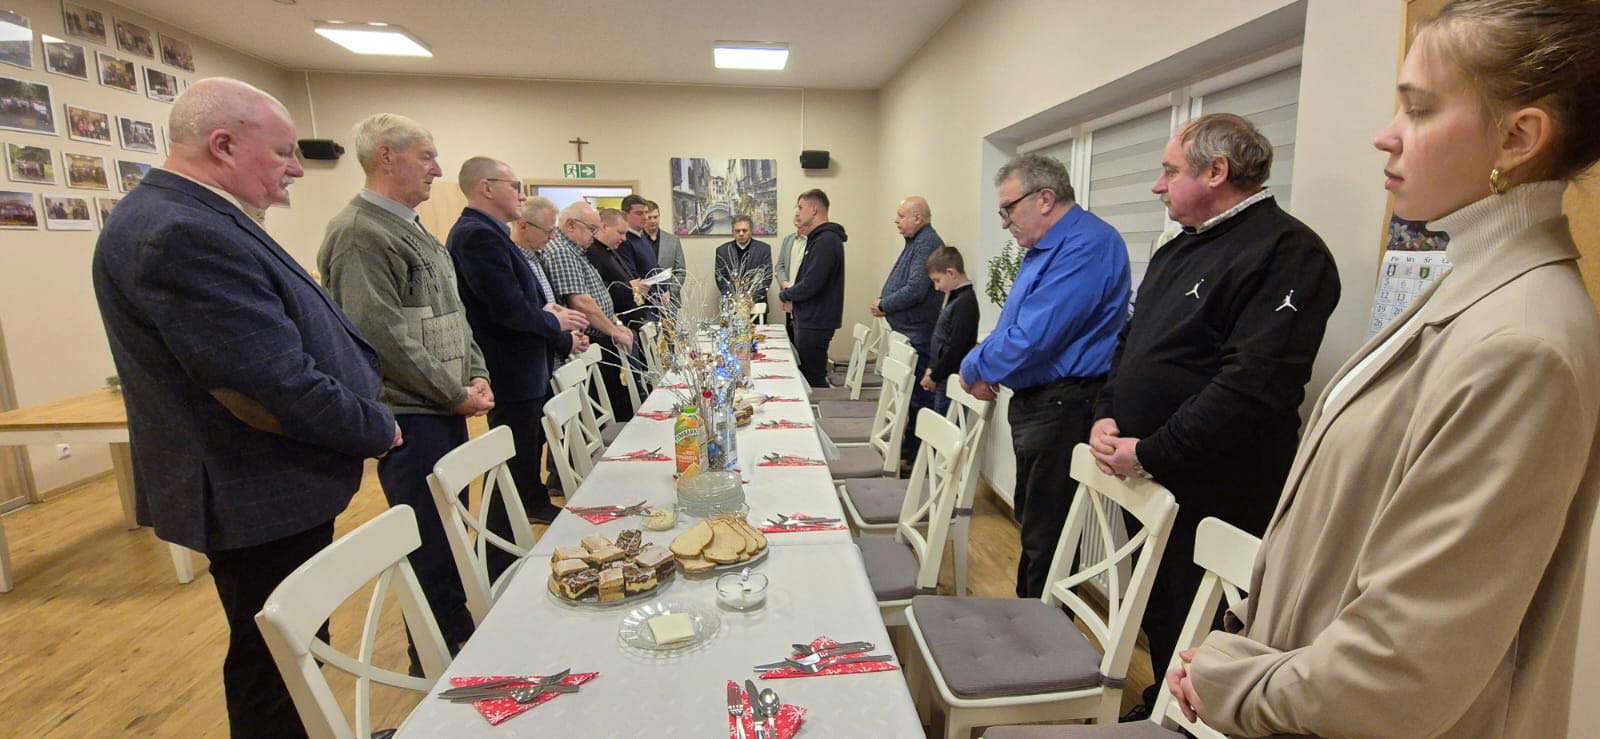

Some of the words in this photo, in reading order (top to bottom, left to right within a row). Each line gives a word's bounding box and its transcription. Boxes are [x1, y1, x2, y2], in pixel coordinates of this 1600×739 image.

[1418, 281, 1423, 289] 7
[1380, 291, 1389, 299] 12
[1397, 293, 1406, 301] 13
[1377, 305, 1386, 313] 19
[1374, 319, 1383, 327] 26
